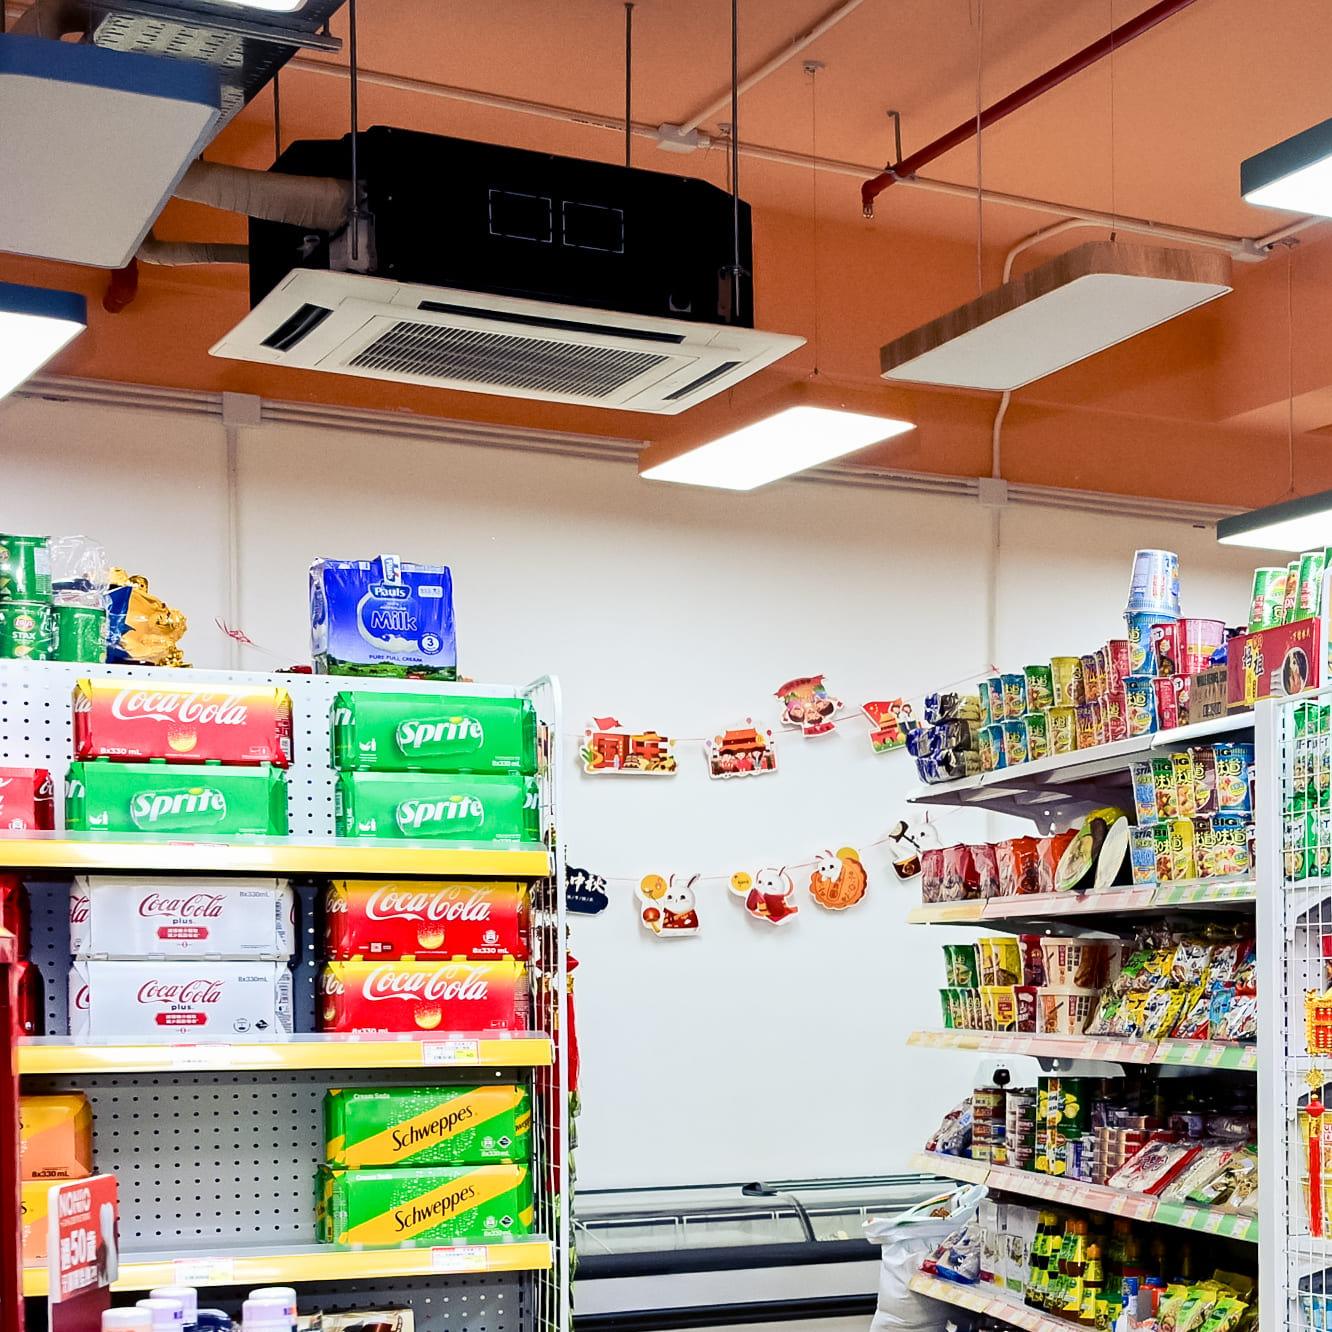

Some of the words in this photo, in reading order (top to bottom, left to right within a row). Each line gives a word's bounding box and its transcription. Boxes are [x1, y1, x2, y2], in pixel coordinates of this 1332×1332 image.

[375, 587, 406, 597] Pauls
[371, 611, 417, 630] Milk
[398, 718, 483, 753] Sprite
[134, 790, 226, 818] Sprite
[398, 796, 483, 832] Sprite
[139, 894, 223, 918] Coca-Cola
[366, 886, 490, 923] Coca-Cola
[137, 980, 221, 1004] Coca-Cola
[363, 966, 488, 1001] Coca-Cola
[171, 1004, 192, 1012] plus
[392, 1105, 473, 1151] Schweppes
[394, 1184, 476, 1231] Schweppes
